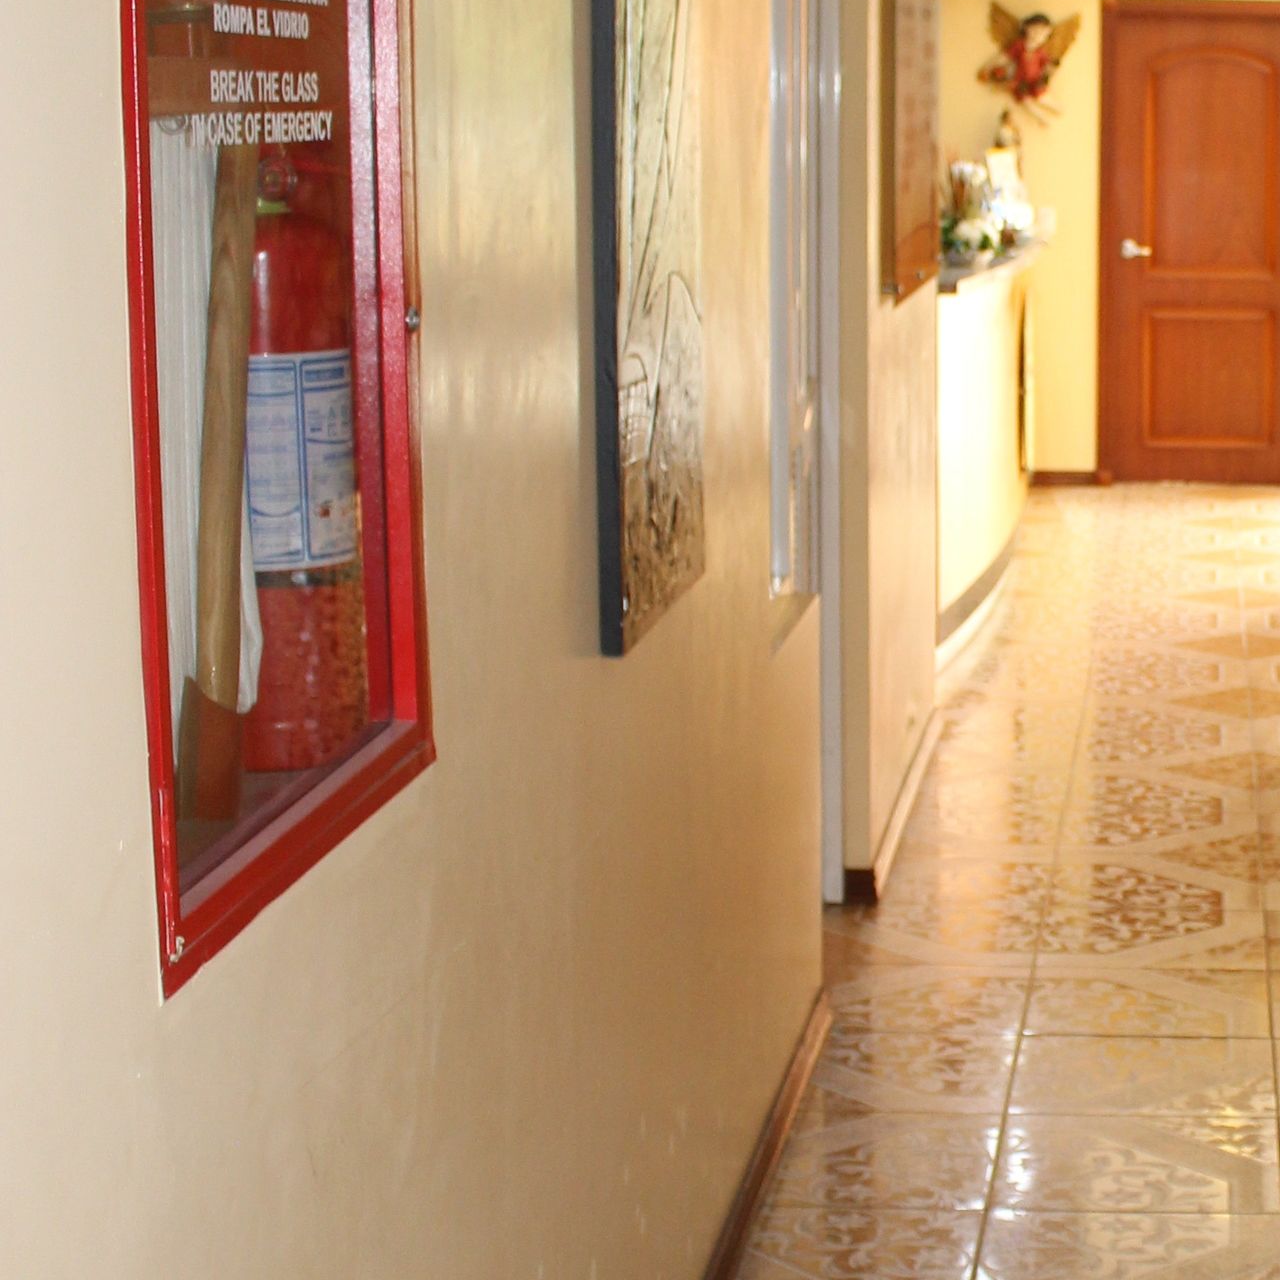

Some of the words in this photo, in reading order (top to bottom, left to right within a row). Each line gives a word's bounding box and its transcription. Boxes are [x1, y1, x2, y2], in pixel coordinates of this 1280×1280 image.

[213, 3, 255, 35] ROMPA
[256, 8, 271, 37] EL
[272, 10, 309, 40] VIDRIO
[210, 70, 254, 102] BREAK
[255, 71, 280, 102] THE
[281, 72, 319, 102] GLASS
[191, 113, 207, 147] IN
[207, 112, 243, 146] CASE
[244, 112, 262, 144] OF
[263, 110, 333, 144] EMERGENCY
